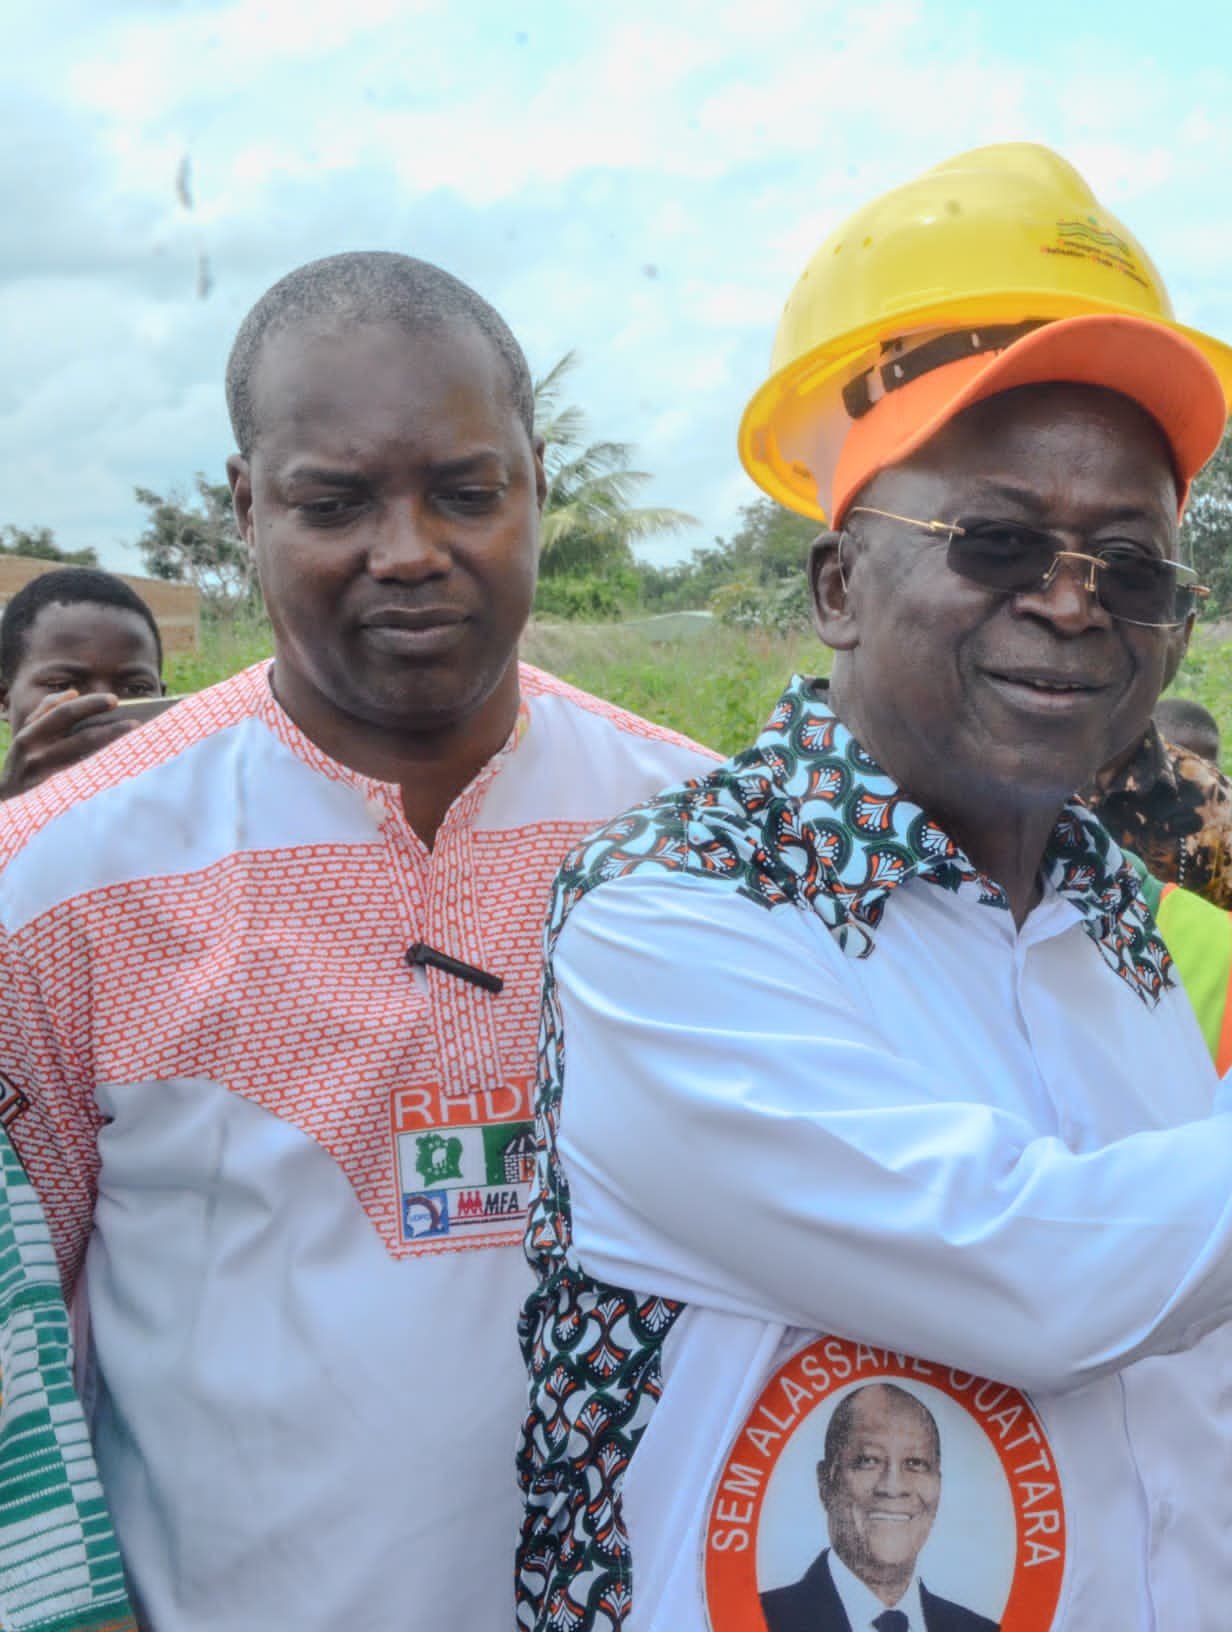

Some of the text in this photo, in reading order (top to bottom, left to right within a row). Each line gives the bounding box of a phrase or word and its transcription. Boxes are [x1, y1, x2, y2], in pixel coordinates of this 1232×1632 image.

[484, 1190, 519, 1216] MFA
[712, 1463, 765, 1552] SEM
[949, 1365, 1061, 1568] OUATTARA
